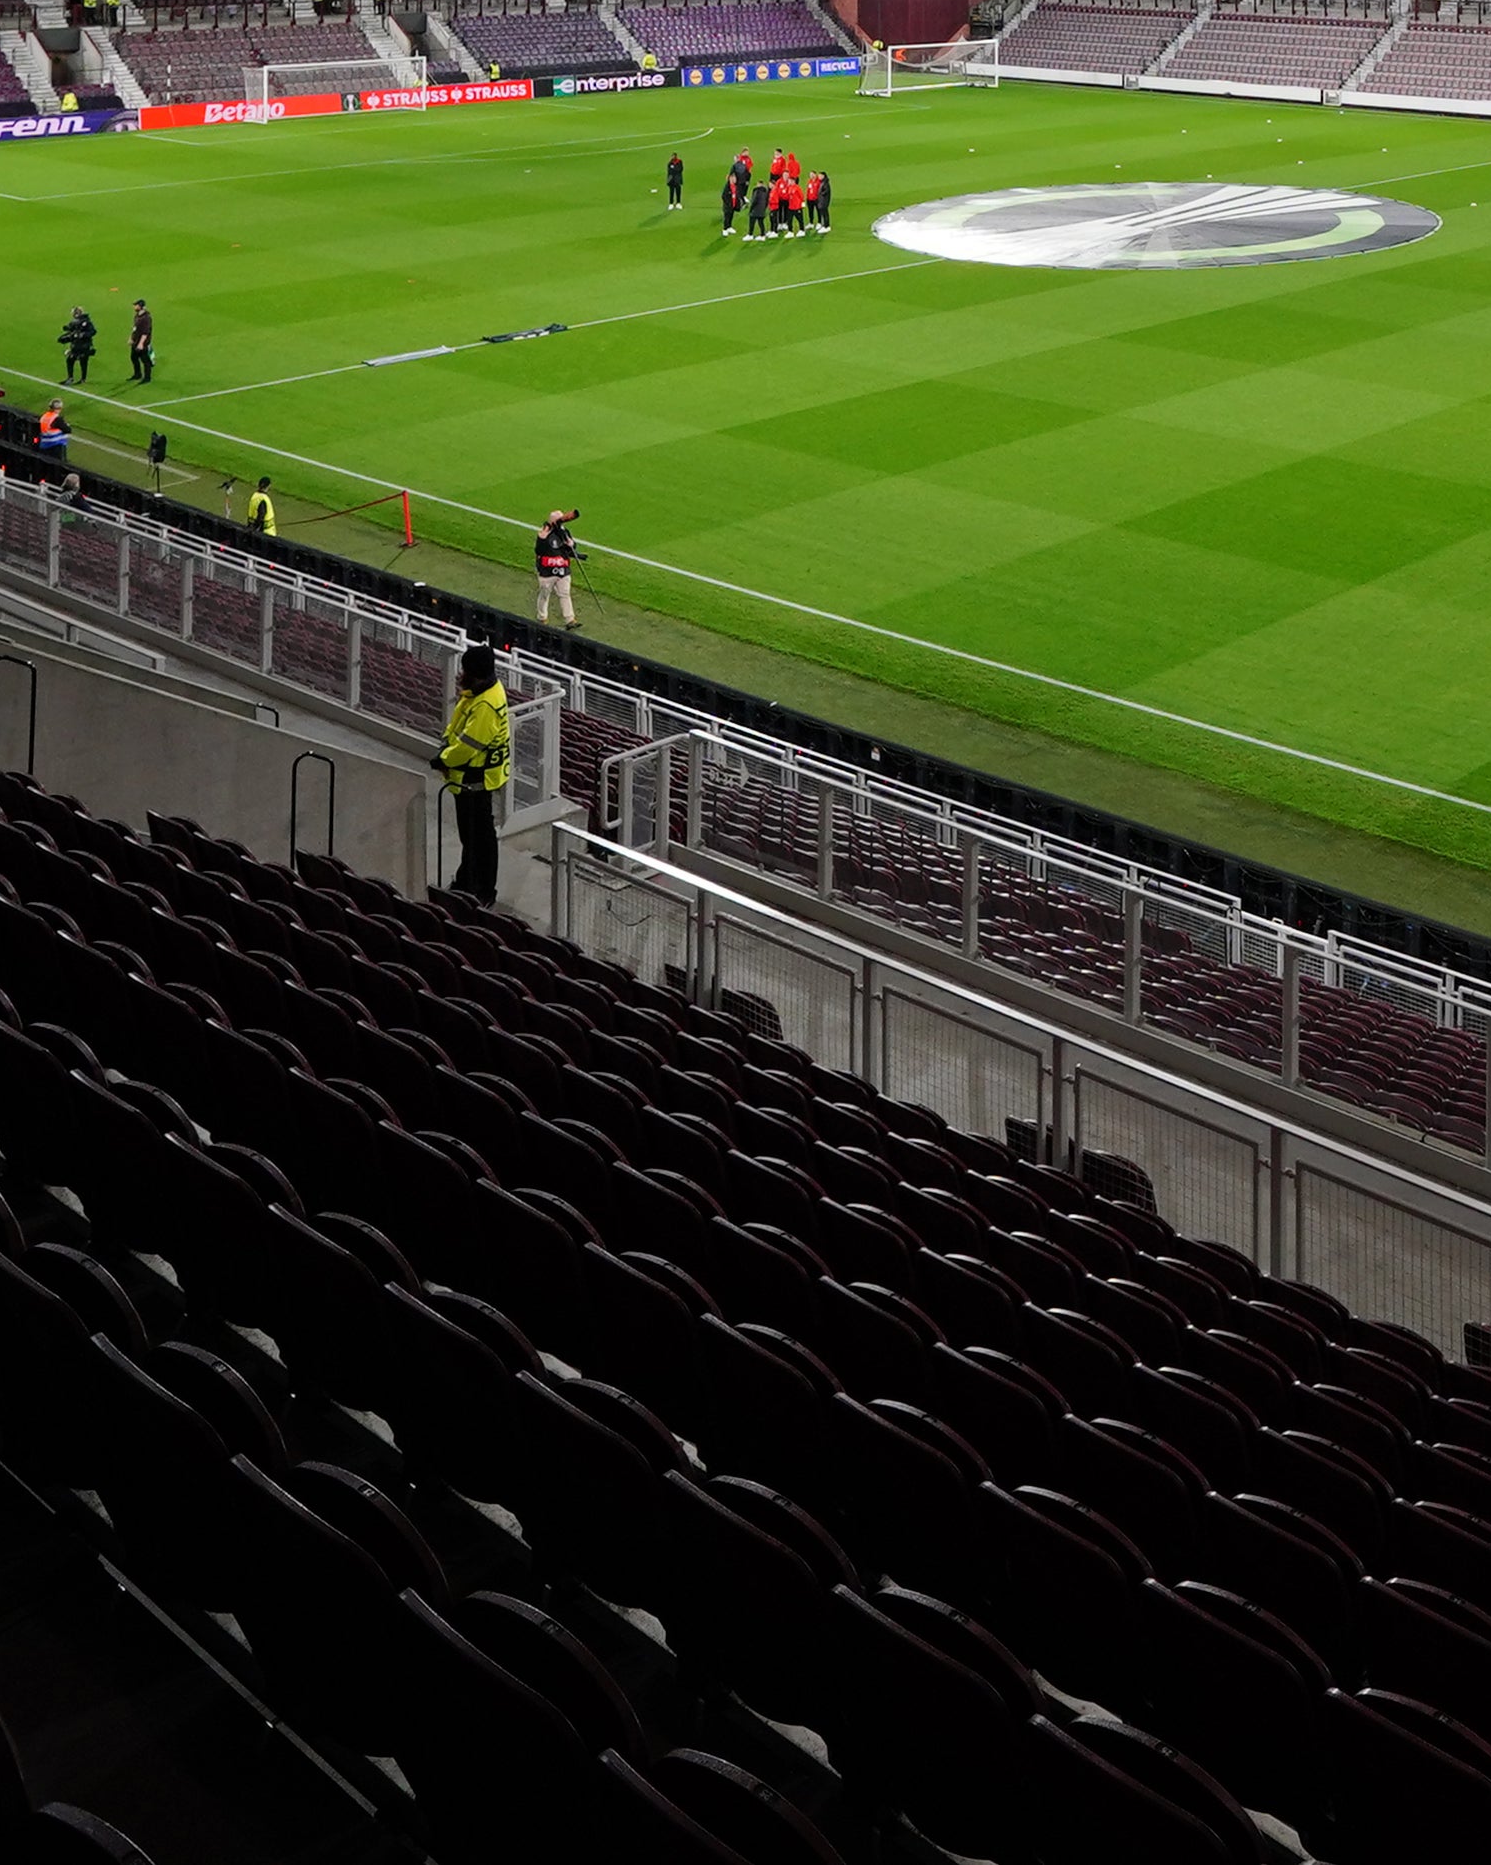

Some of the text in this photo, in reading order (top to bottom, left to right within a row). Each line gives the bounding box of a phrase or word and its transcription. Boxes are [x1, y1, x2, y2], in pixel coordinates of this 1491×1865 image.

[820, 60, 857, 72] RECYCLE
[556, 72, 665, 93] enterprise
[382, 89, 448, 107] STRAUSS
[465, 84, 527, 101] STRAUSS
[204, 102, 285, 124] Betano
